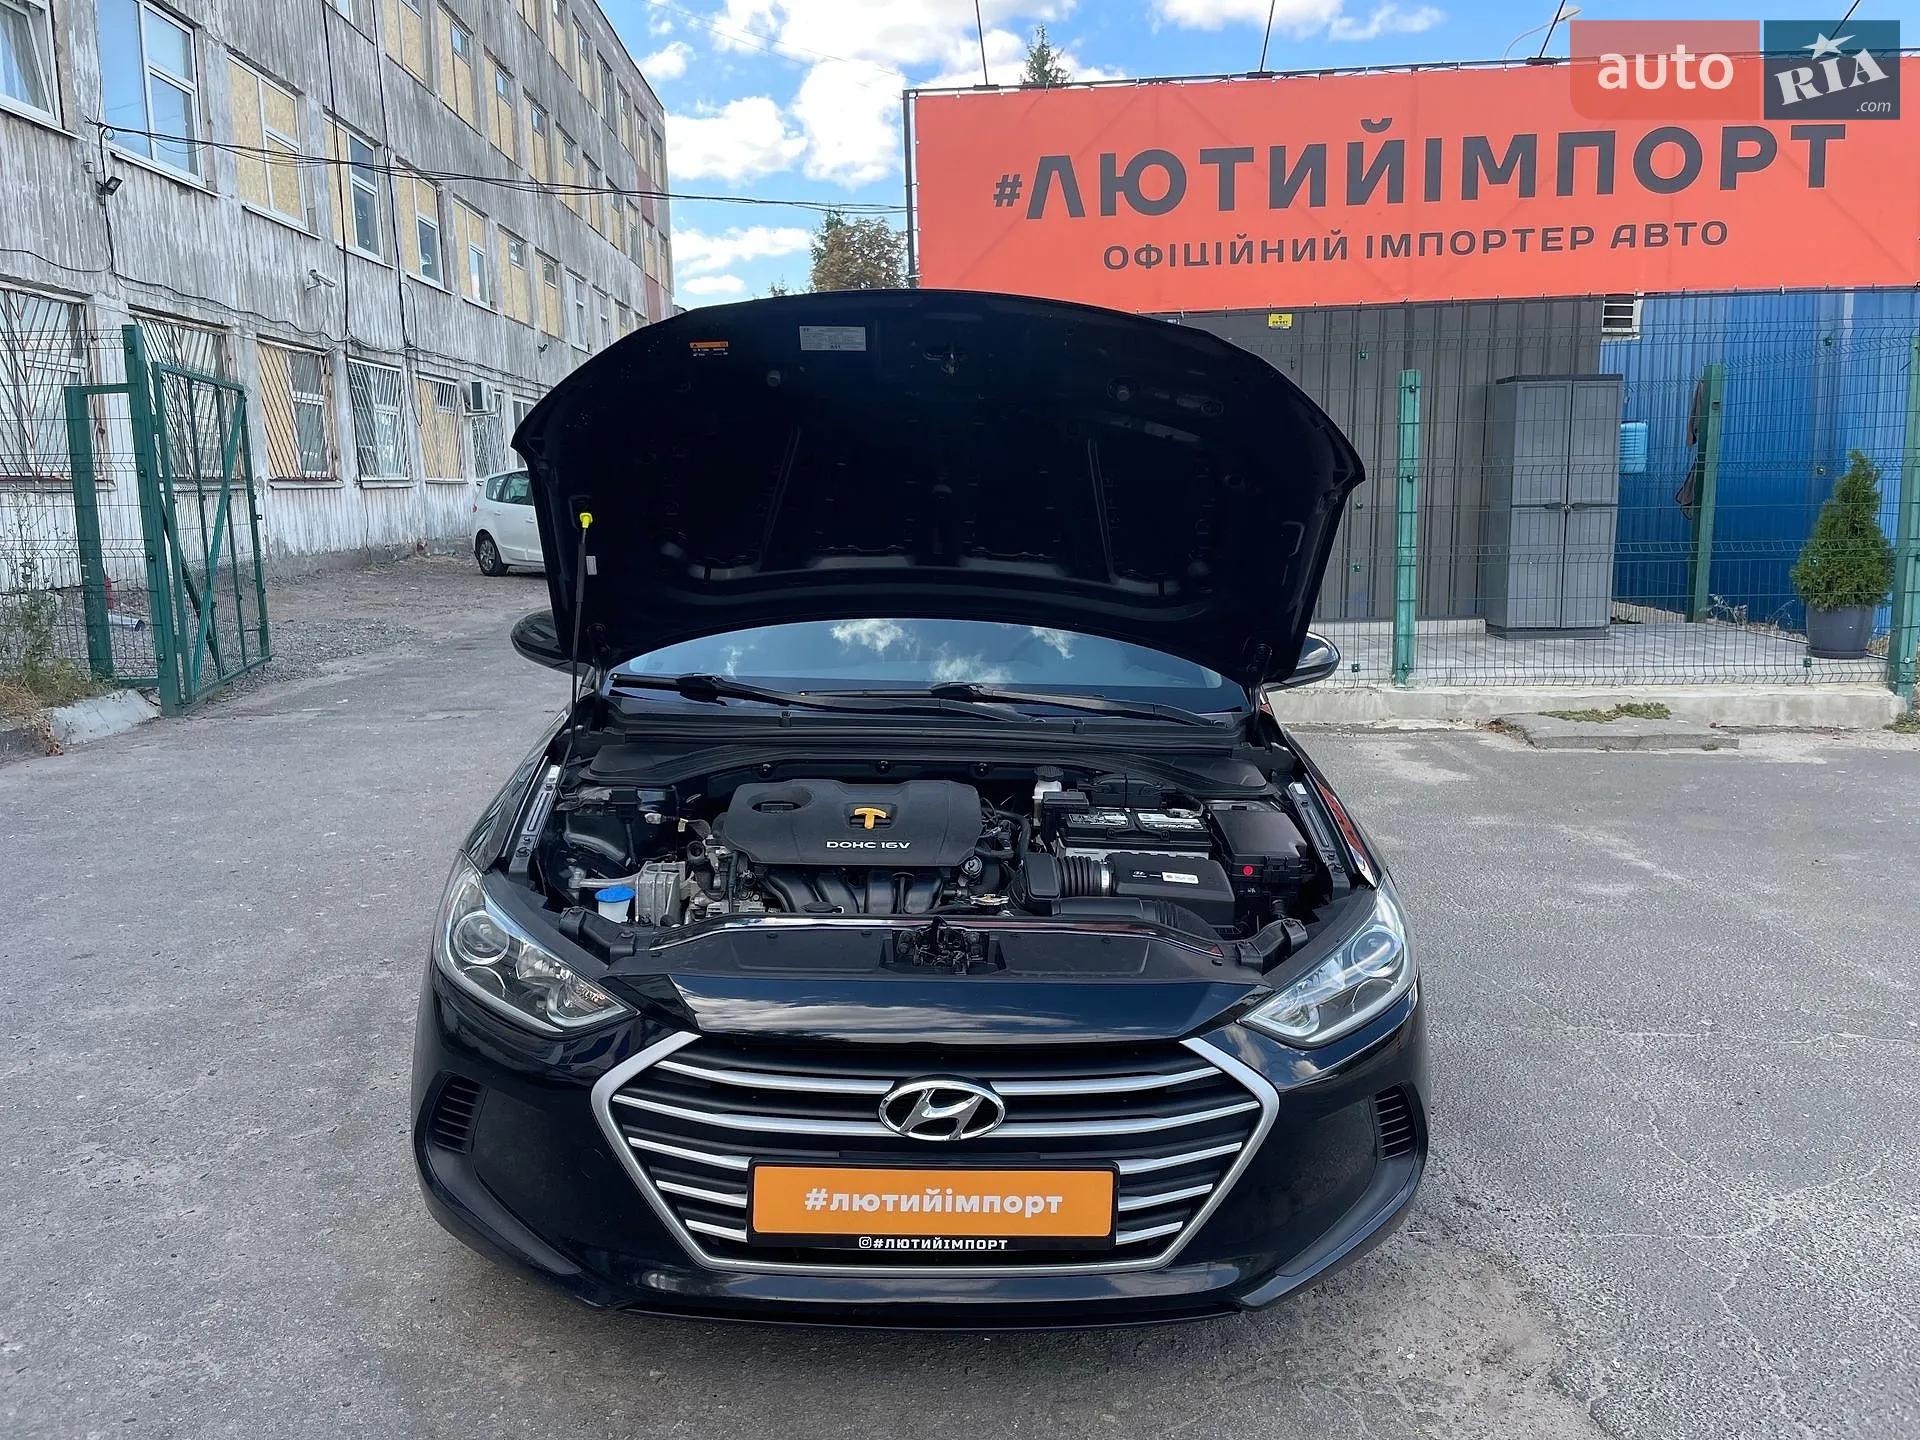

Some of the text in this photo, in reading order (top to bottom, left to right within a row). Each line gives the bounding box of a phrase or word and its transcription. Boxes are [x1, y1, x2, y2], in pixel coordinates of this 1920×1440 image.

[993, 117, 1847, 220] #ЛЮТИЙІМПОРТ
[1103, 220, 1729, 270] ОФІЦІЙНИЙ ІМПОРТЕР АВТО
[826, 841, 911, 849] DOHC 16V
[804, 1188, 1063, 1218] #лютийімпорт
